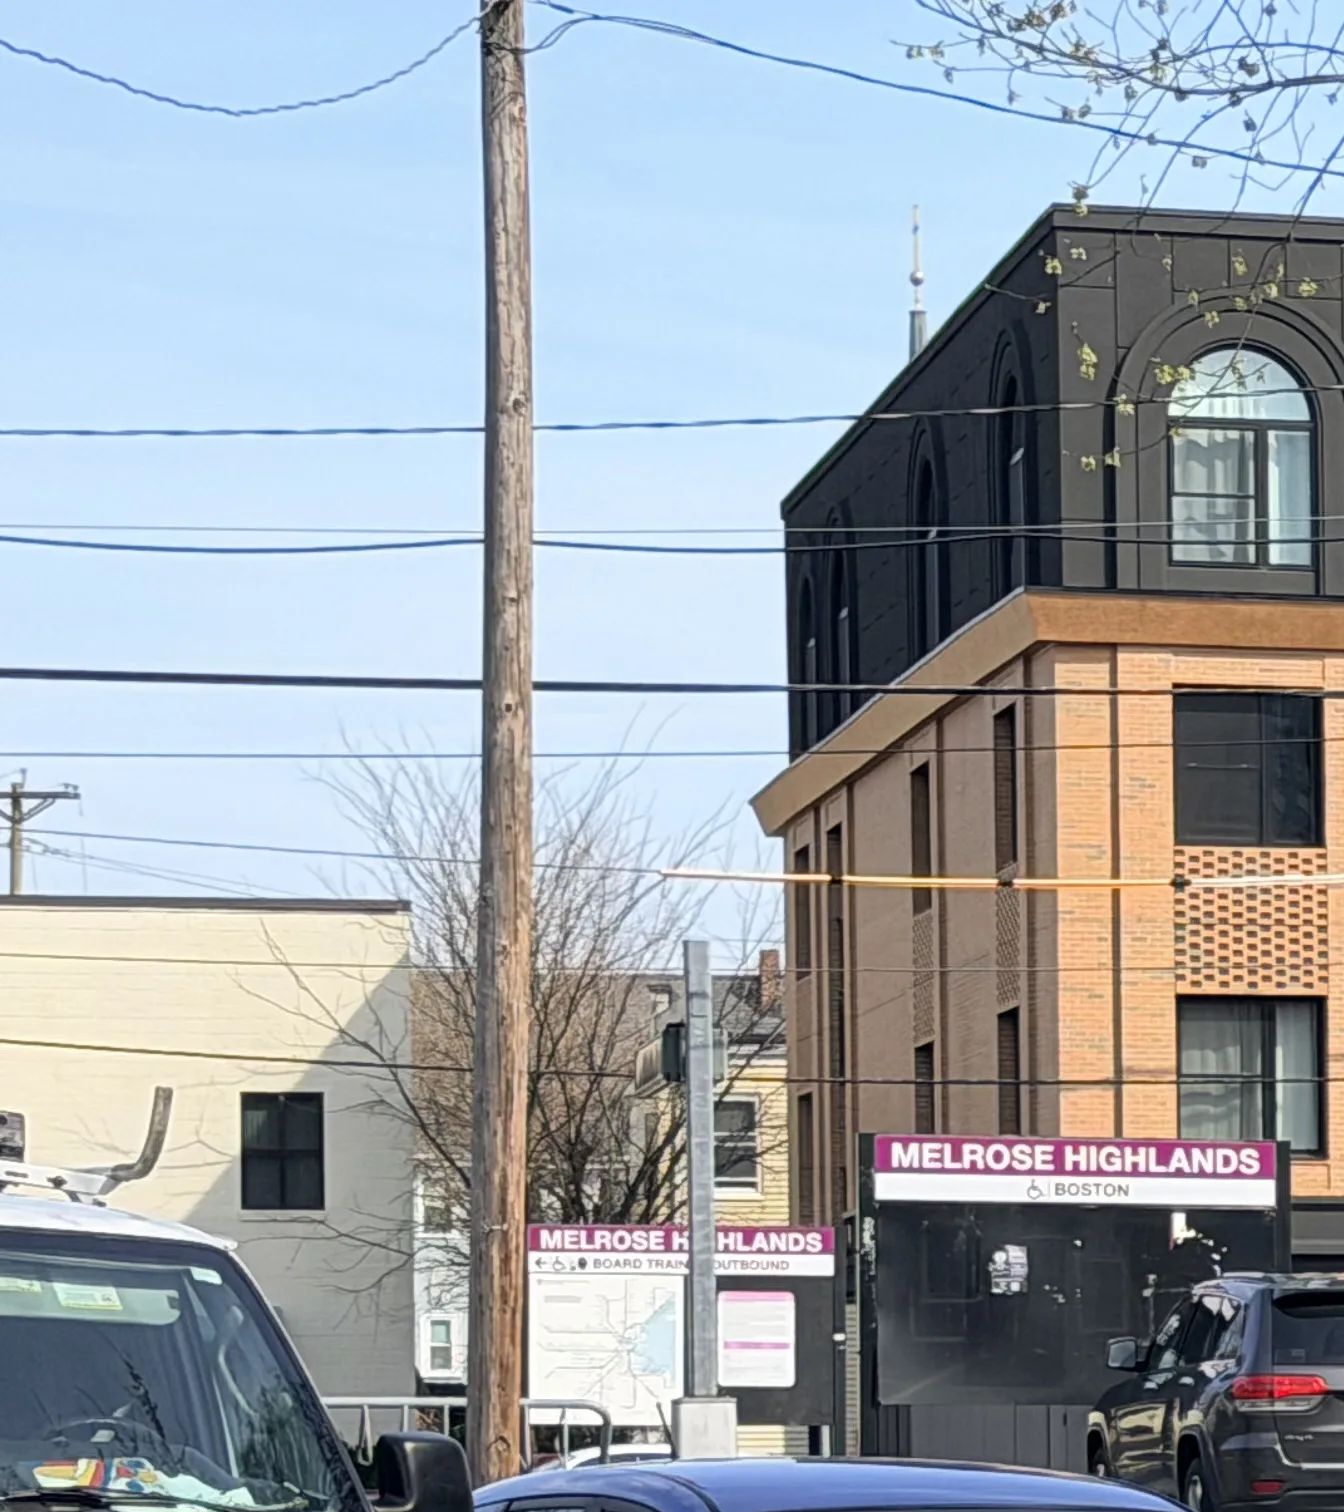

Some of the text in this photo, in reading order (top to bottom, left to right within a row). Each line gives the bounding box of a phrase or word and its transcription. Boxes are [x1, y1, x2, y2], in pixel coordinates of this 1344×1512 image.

[891, 1142, 1261, 1175] MELROSE HIGHLANDS
[1054, 1183, 1130, 1198] BOSTON
[540, 1229, 823, 1253] MELROSE HHLANDS
[593, 1258, 643, 1269] BOARD
[648, 1259, 690, 1269] TRAIN
